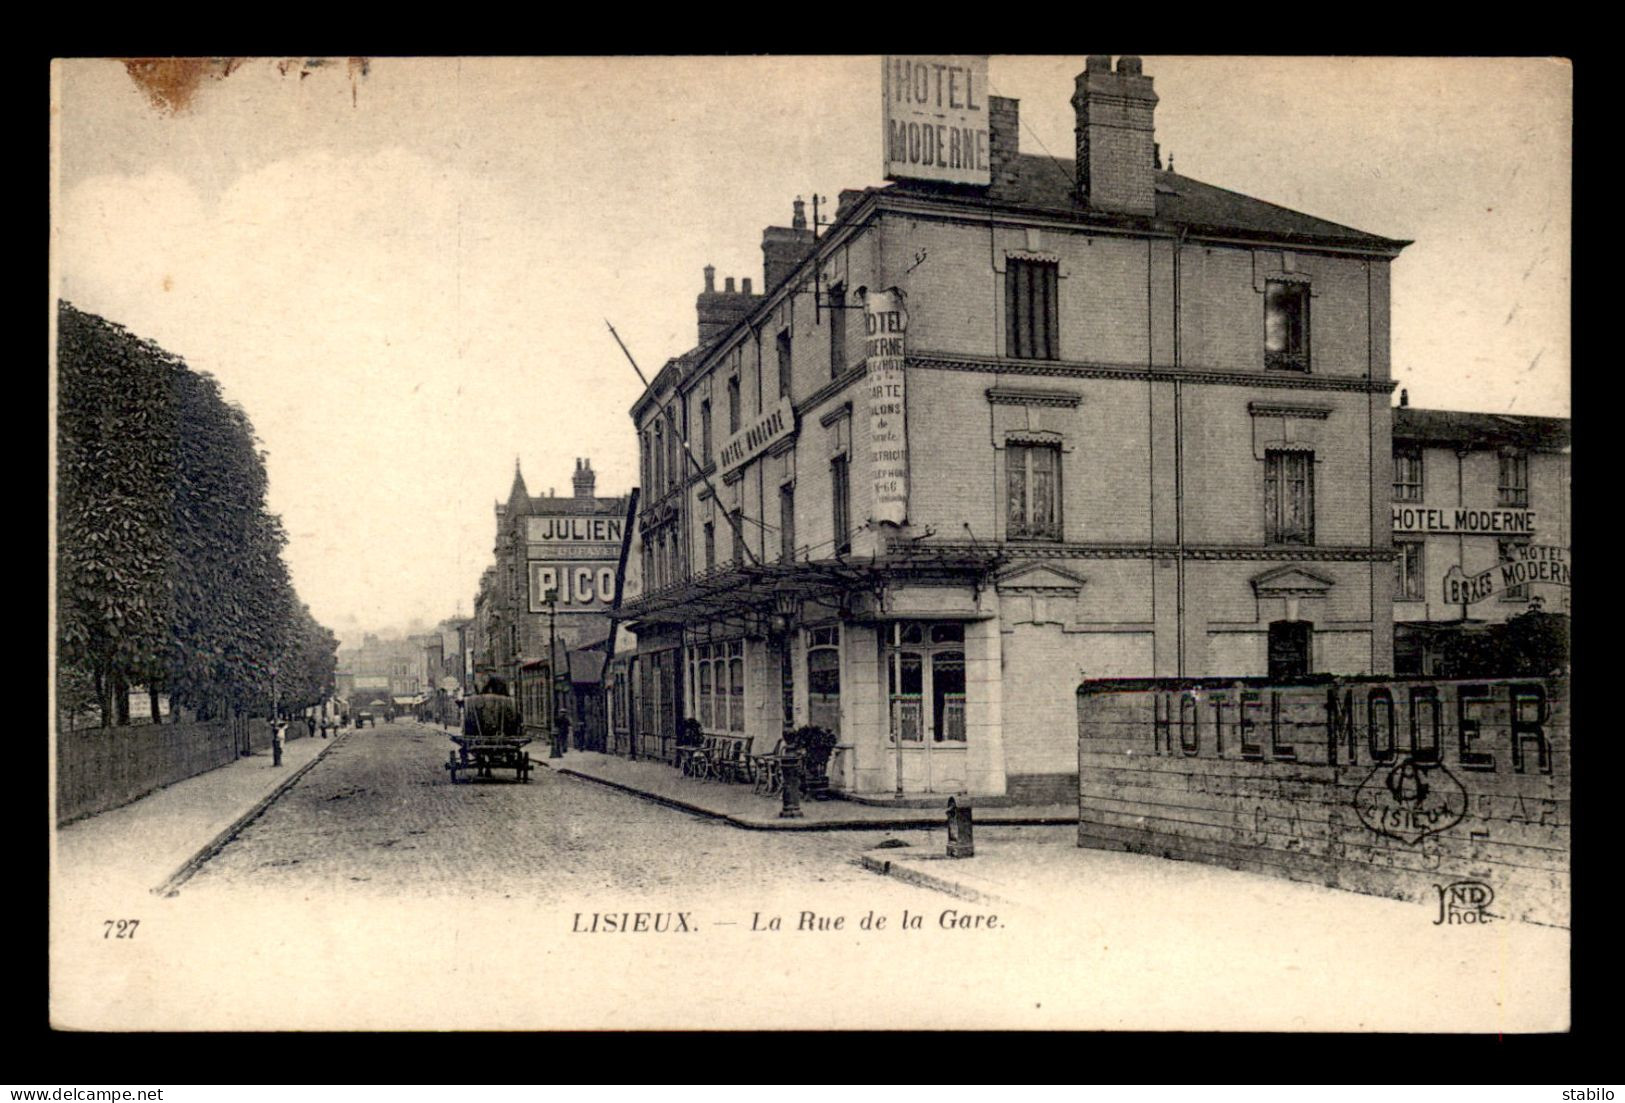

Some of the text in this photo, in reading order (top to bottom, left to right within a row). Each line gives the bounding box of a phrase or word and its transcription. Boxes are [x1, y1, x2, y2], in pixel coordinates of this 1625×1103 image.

[894, 58, 981, 111] HOTEL
[889, 119, 988, 172] MODERNE
[542, 519, 622, 540] JULIEN
[1392, 508, 1536, 532] HOTEL MODERNE
[1520, 546, 1565, 562] HOTEL
[1452, 572, 1492, 603] BOXES
[1154, 683, 1552, 774] HOTEL MODER
